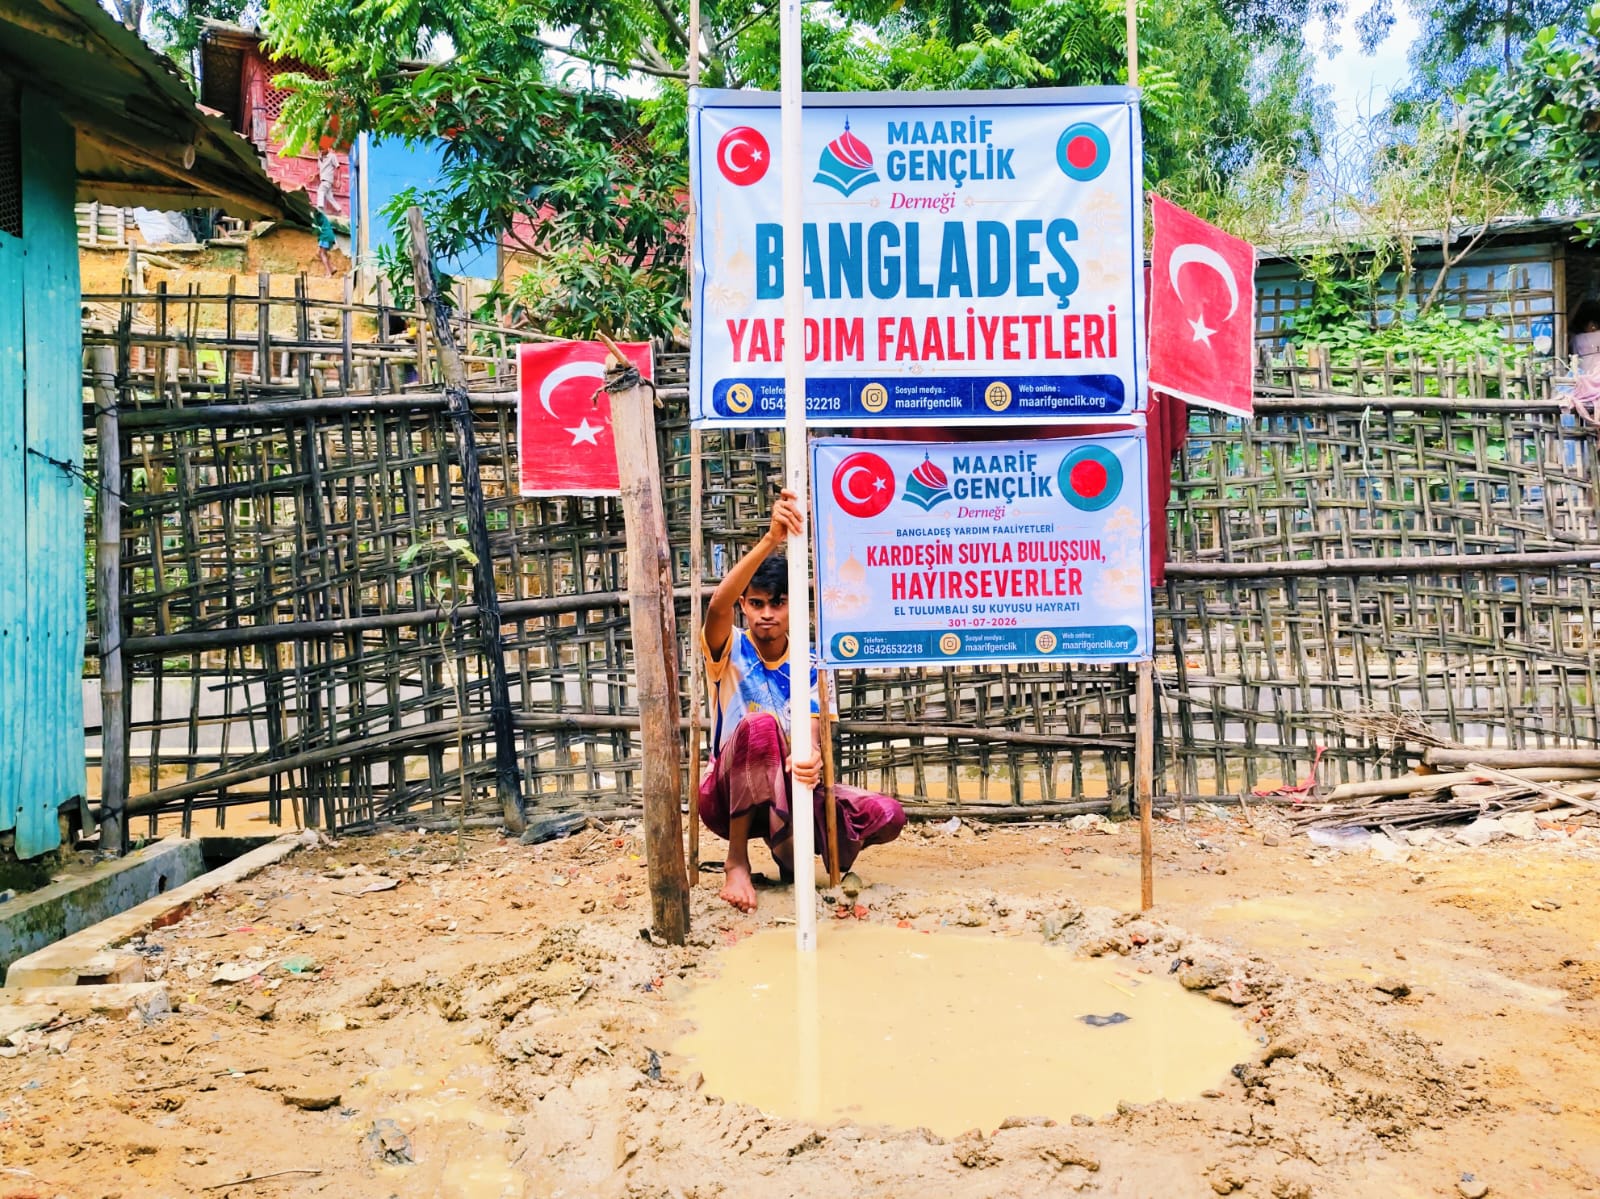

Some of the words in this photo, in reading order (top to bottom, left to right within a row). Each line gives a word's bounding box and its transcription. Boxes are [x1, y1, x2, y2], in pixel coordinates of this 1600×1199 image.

[887, 115, 993, 145] MAARİF
[886, 142, 1016, 188] GENÇLİK
[890, 192, 956, 214] Derneği
[755, 218, 1079, 309] BANGLADEŞ
[877, 304, 1118, 361] FAALİYETLERİ
[895, 386, 918, 396] Sosyal
[919, 386, 942, 396] medya
[1019, 384, 1034, 392] Web
[1035, 384, 1056, 393] online
[761, 397, 841, 411] 05432218
[895, 397, 962, 410] maarifgenclik
[1019, 395, 1106, 408] maarifgenclik.org
[953, 450, 1038, 474] MAARİF
[954, 471, 1053, 504] GENÇLİK
[957, 506, 1006, 520] Derneği
[896, 527, 951, 537] BANGLADEŞ
[954, 526, 990, 536] YARDIM
[992, 523, 1054, 534] FAALİYETLERİ
[867, 540, 953, 570] KARDEŞİN
[958, 542, 1013, 564] SUYLA
[1017, 539, 1106, 566] BULUŞSUN,
[891, 567, 1083, 600] HAYIRSEVERLER
[894, 606, 906, 616] EL
[909, 604, 968, 615] TULUMBALI
[972, 604, 986, 614] SU
[989, 603, 1032, 613] KUYUSU
[1035, 602, 1080, 612] HAYRATI
[948, 617, 1017, 628] 301-07-2026
[863, 644, 923, 655] 05426532218
[965, 642, 1017, 653] maarifgenclik
[1062, 640, 1129, 650] maarifgenclik.org
